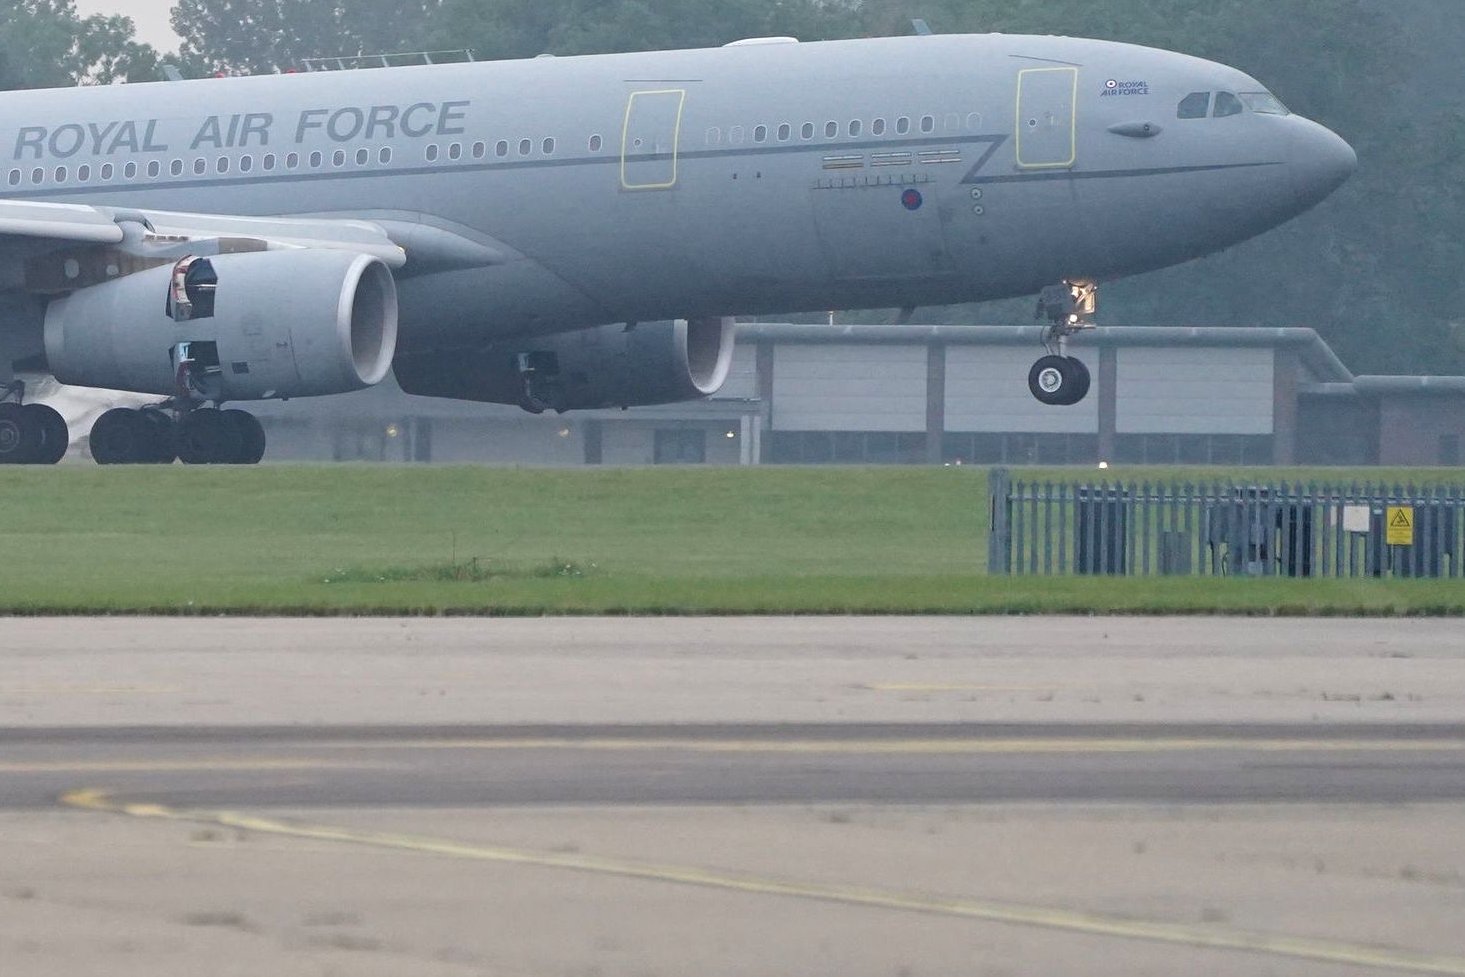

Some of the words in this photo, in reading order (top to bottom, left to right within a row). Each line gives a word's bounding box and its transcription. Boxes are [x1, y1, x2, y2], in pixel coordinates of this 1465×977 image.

[1100, 88, 1117, 96] AIR
[1118, 87, 1150, 96] FORCE
[13, 119, 168, 160] ROYAL
[189, 112, 273, 150] AIR
[294, 100, 470, 143] FORCE
